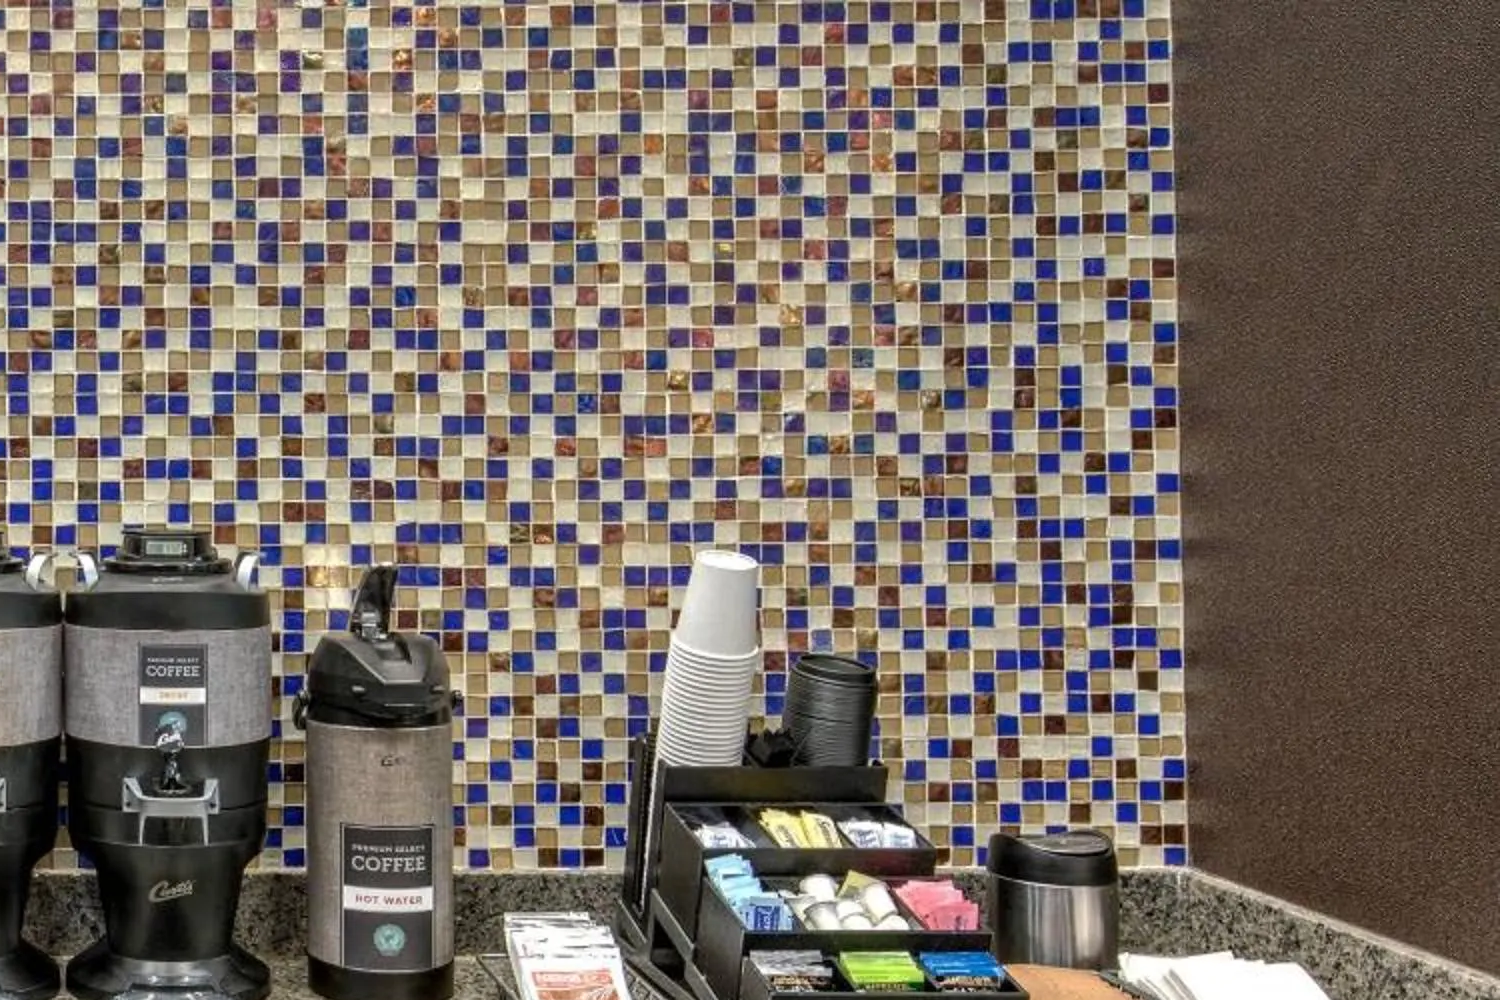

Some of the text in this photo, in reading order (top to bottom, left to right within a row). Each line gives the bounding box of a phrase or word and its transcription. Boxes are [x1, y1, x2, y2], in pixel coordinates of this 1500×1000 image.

[145, 664, 201, 677] COFFEE
[351, 855, 426, 873] COFFEE
[355, 894, 423, 906] HOT WATER
